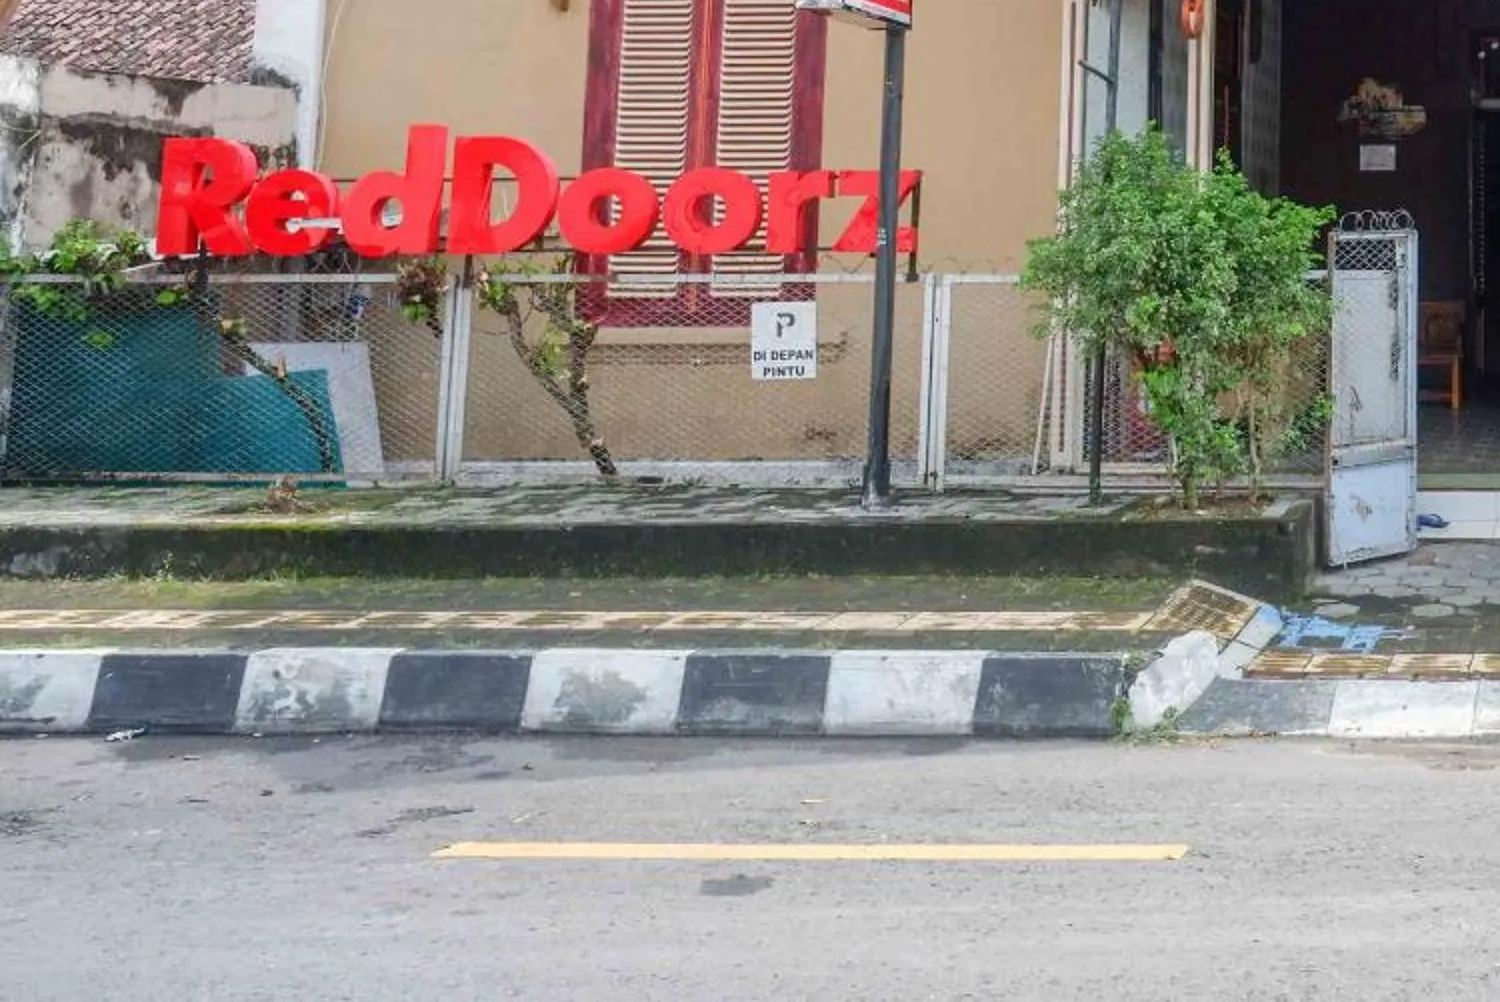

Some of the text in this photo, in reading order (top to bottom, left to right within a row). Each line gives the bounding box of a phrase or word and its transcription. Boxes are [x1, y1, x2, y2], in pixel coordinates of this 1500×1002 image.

[155, 124, 923, 257] RedDoorz
[776, 312, 796, 338] P
[754, 350, 813, 361] DI DEPAN
[763, 366, 805, 377] PINTU
